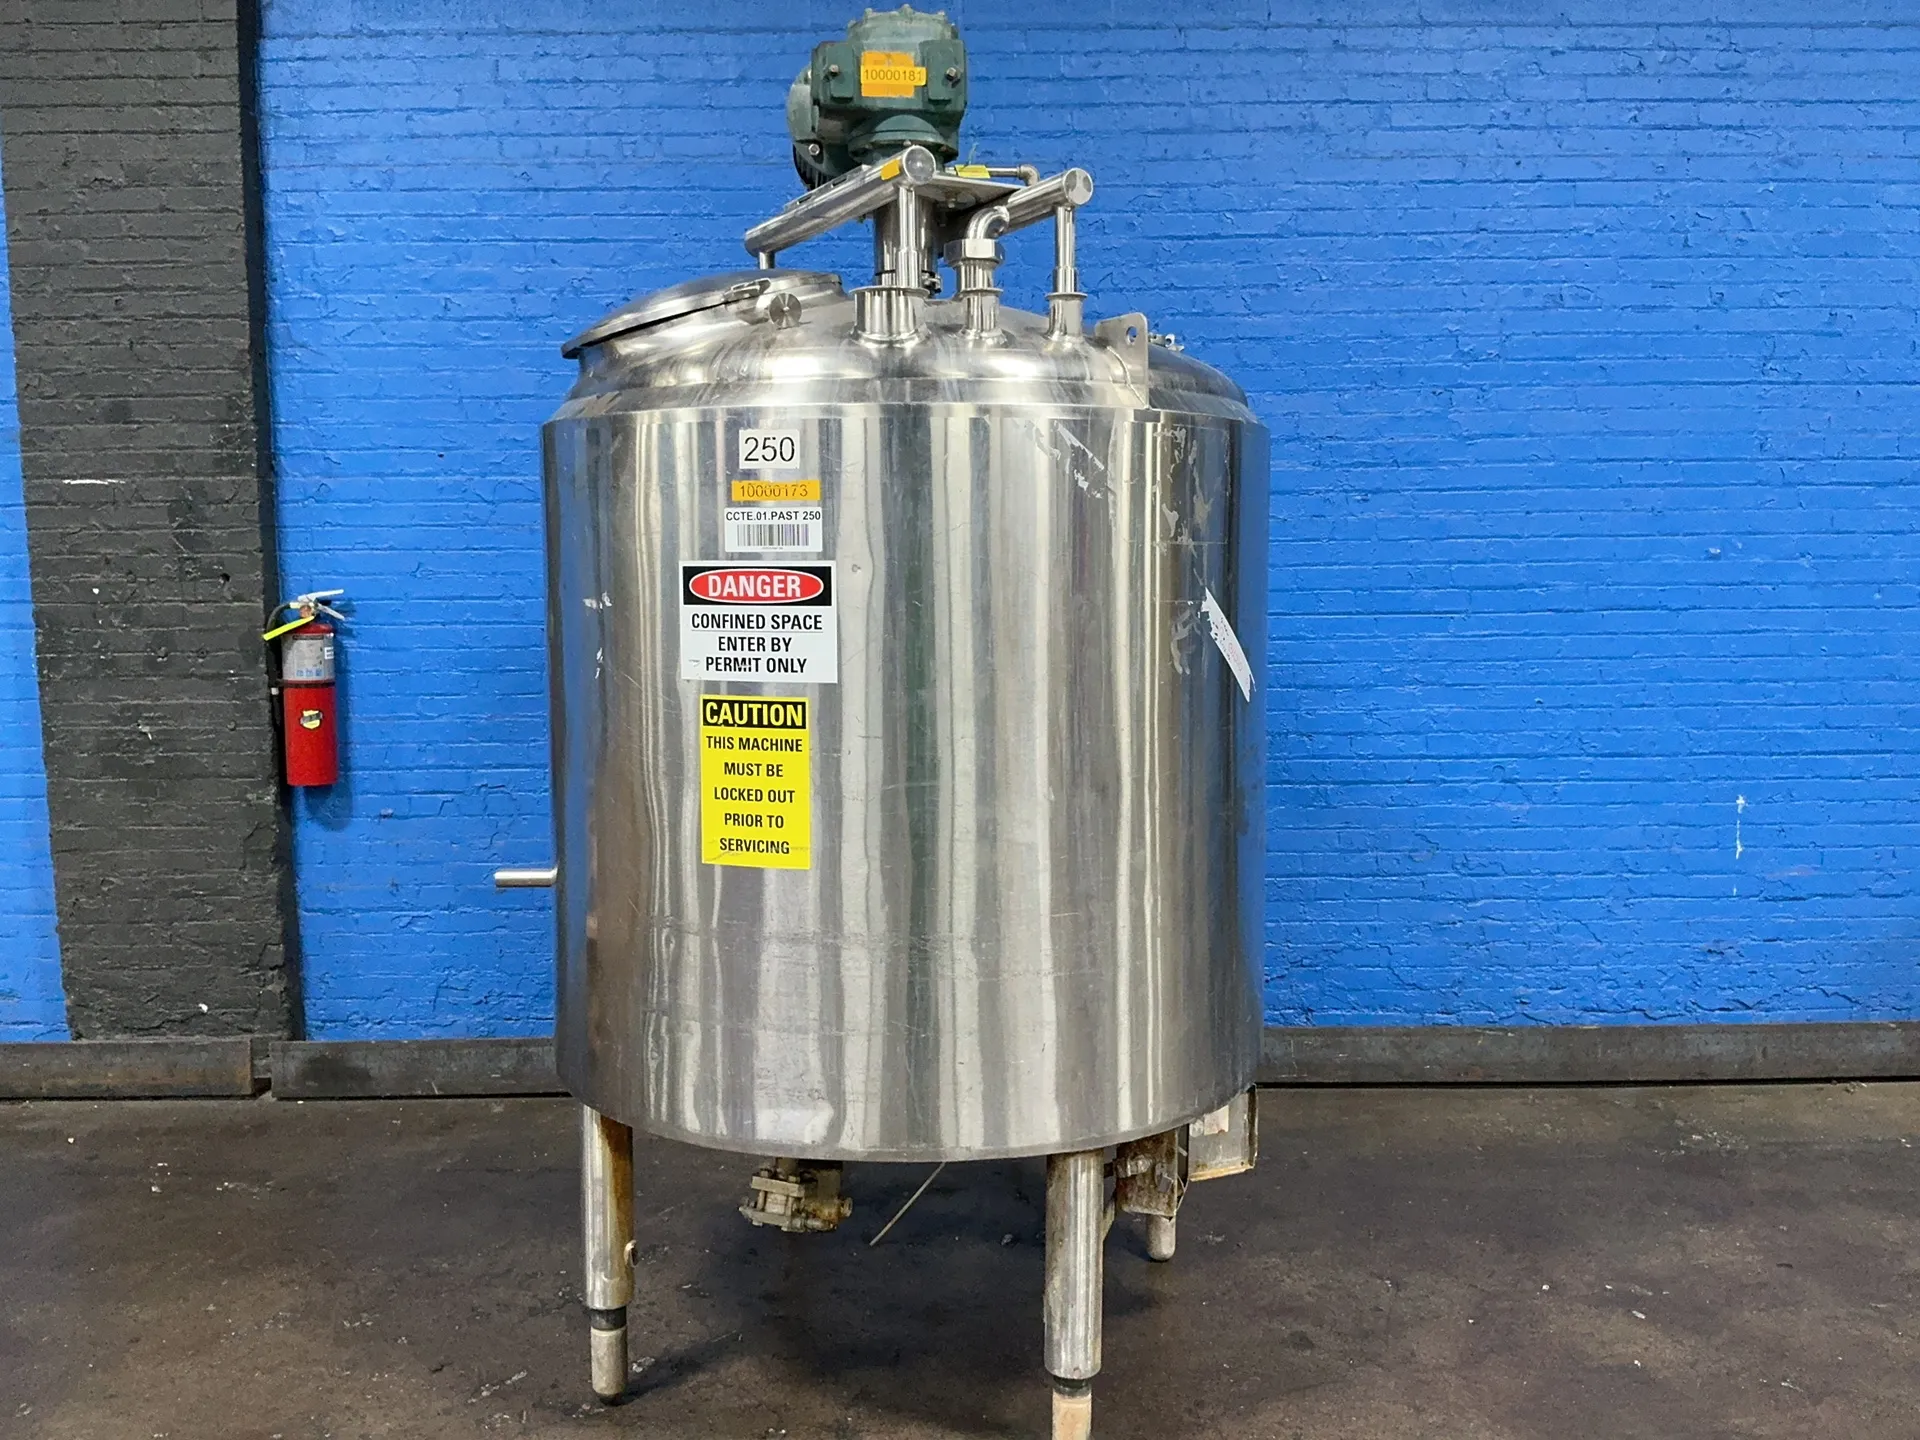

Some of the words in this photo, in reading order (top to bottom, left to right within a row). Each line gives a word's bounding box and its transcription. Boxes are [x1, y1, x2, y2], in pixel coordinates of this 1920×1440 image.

[864, 69, 922, 82] 10000181
[744, 436, 795, 462] 250
[740, 483, 809, 498] 10000173
[725, 511, 799, 521] CCTE.01.PAST
[802, 511, 821, 521] 250
[708, 575, 801, 598] DANGER
[692, 614, 766, 630] CONFINED
[771, 615, 823, 630] SPACE
[718, 637, 766, 652] ENTER
[771, 638, 792, 653] BY
[706, 657, 762, 672] PERMIT
[766, 658, 808, 674] ONLY
[705, 701, 803, 727] CAUTION
[706, 736, 735, 750] THIS
[738, 737, 803, 752] MACHINE
[724, 762, 762, 777] MUST
[766, 764, 784, 778] BE
[714, 787, 763, 802] LOCKED
[767, 789, 796, 804] OUT
[724, 812, 763, 828] PRIOR
[767, 815, 784, 829] TO
[719, 837, 790, 855] SERVICING
